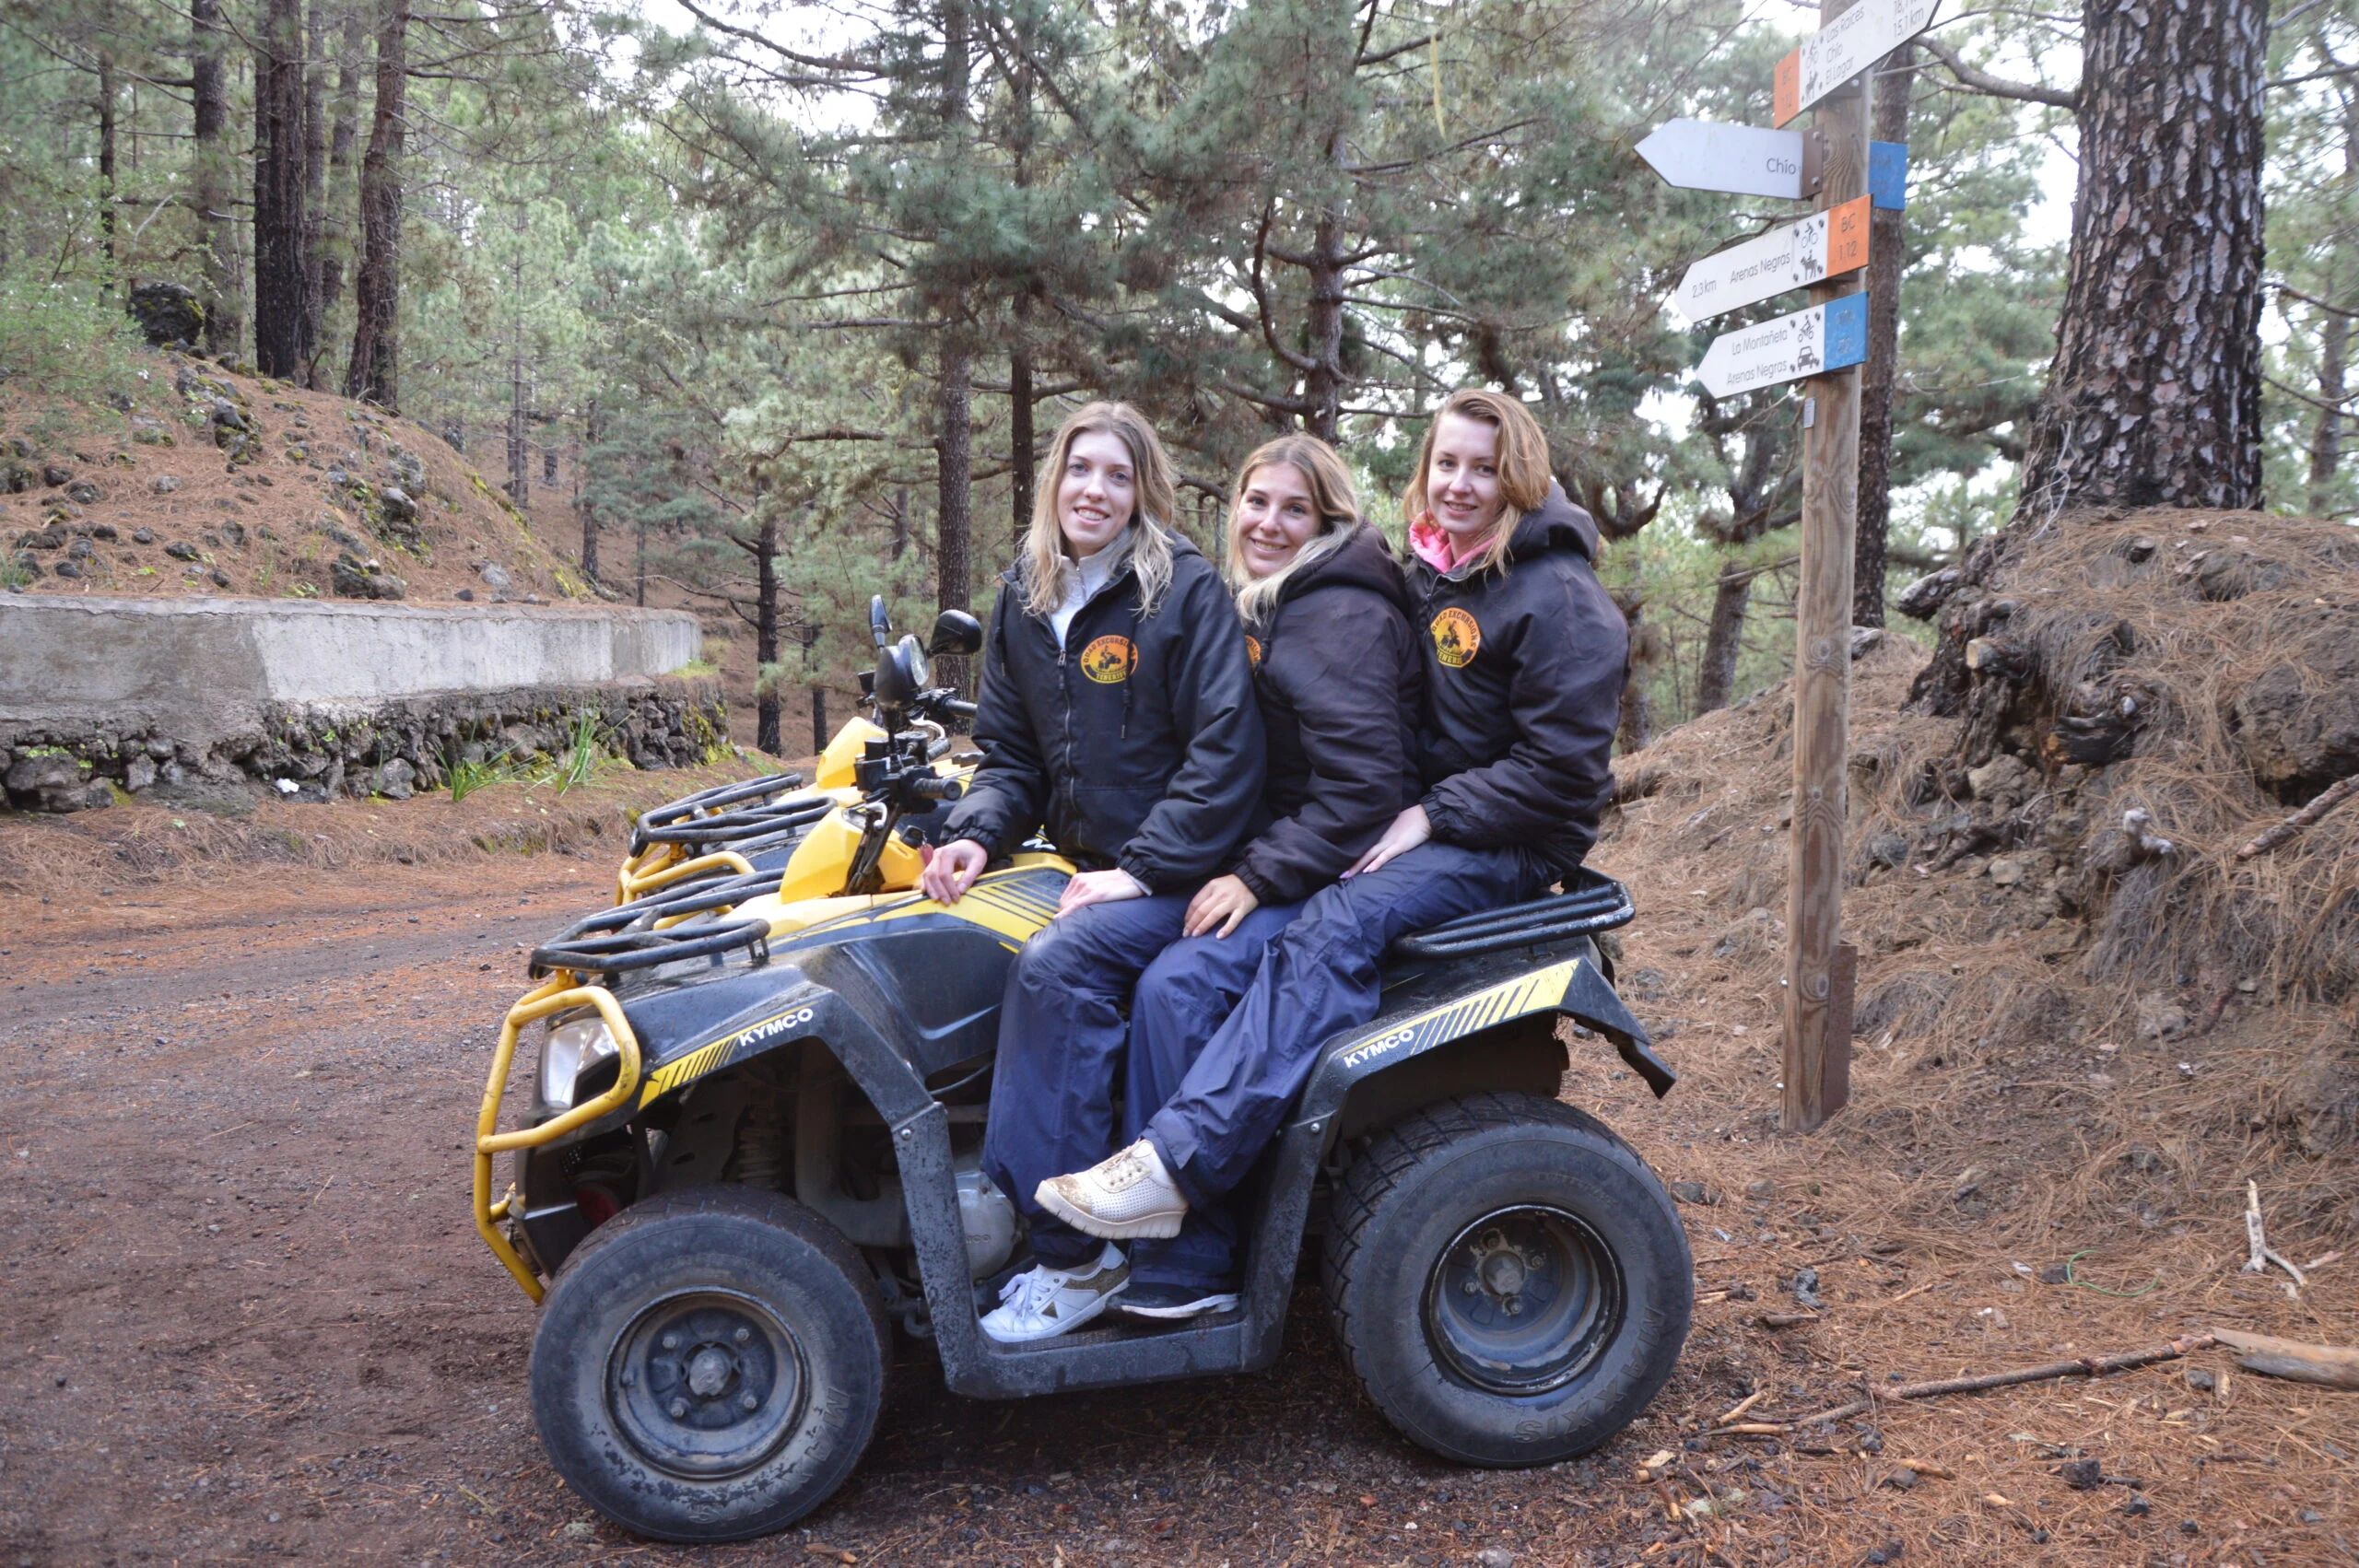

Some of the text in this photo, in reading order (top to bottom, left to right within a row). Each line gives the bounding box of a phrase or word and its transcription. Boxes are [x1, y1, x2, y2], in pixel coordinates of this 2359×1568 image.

[1909, 7, 1924, 28] km
[1766, 158, 1797, 175] Chío
[1840, 213, 1856, 233] BC
[1730, 264, 1759, 284] Arenas
[1760, 252, 1790, 274] Negras
[1732, 342, 1742, 356] La
[1727, 360, 1788, 384] Arenas Negras
[1448, 610, 1478, 648] EXCURSIONS
[739, 1008, 814, 1047] KYMCO
[1344, 1029, 1414, 1069] KYMCO
